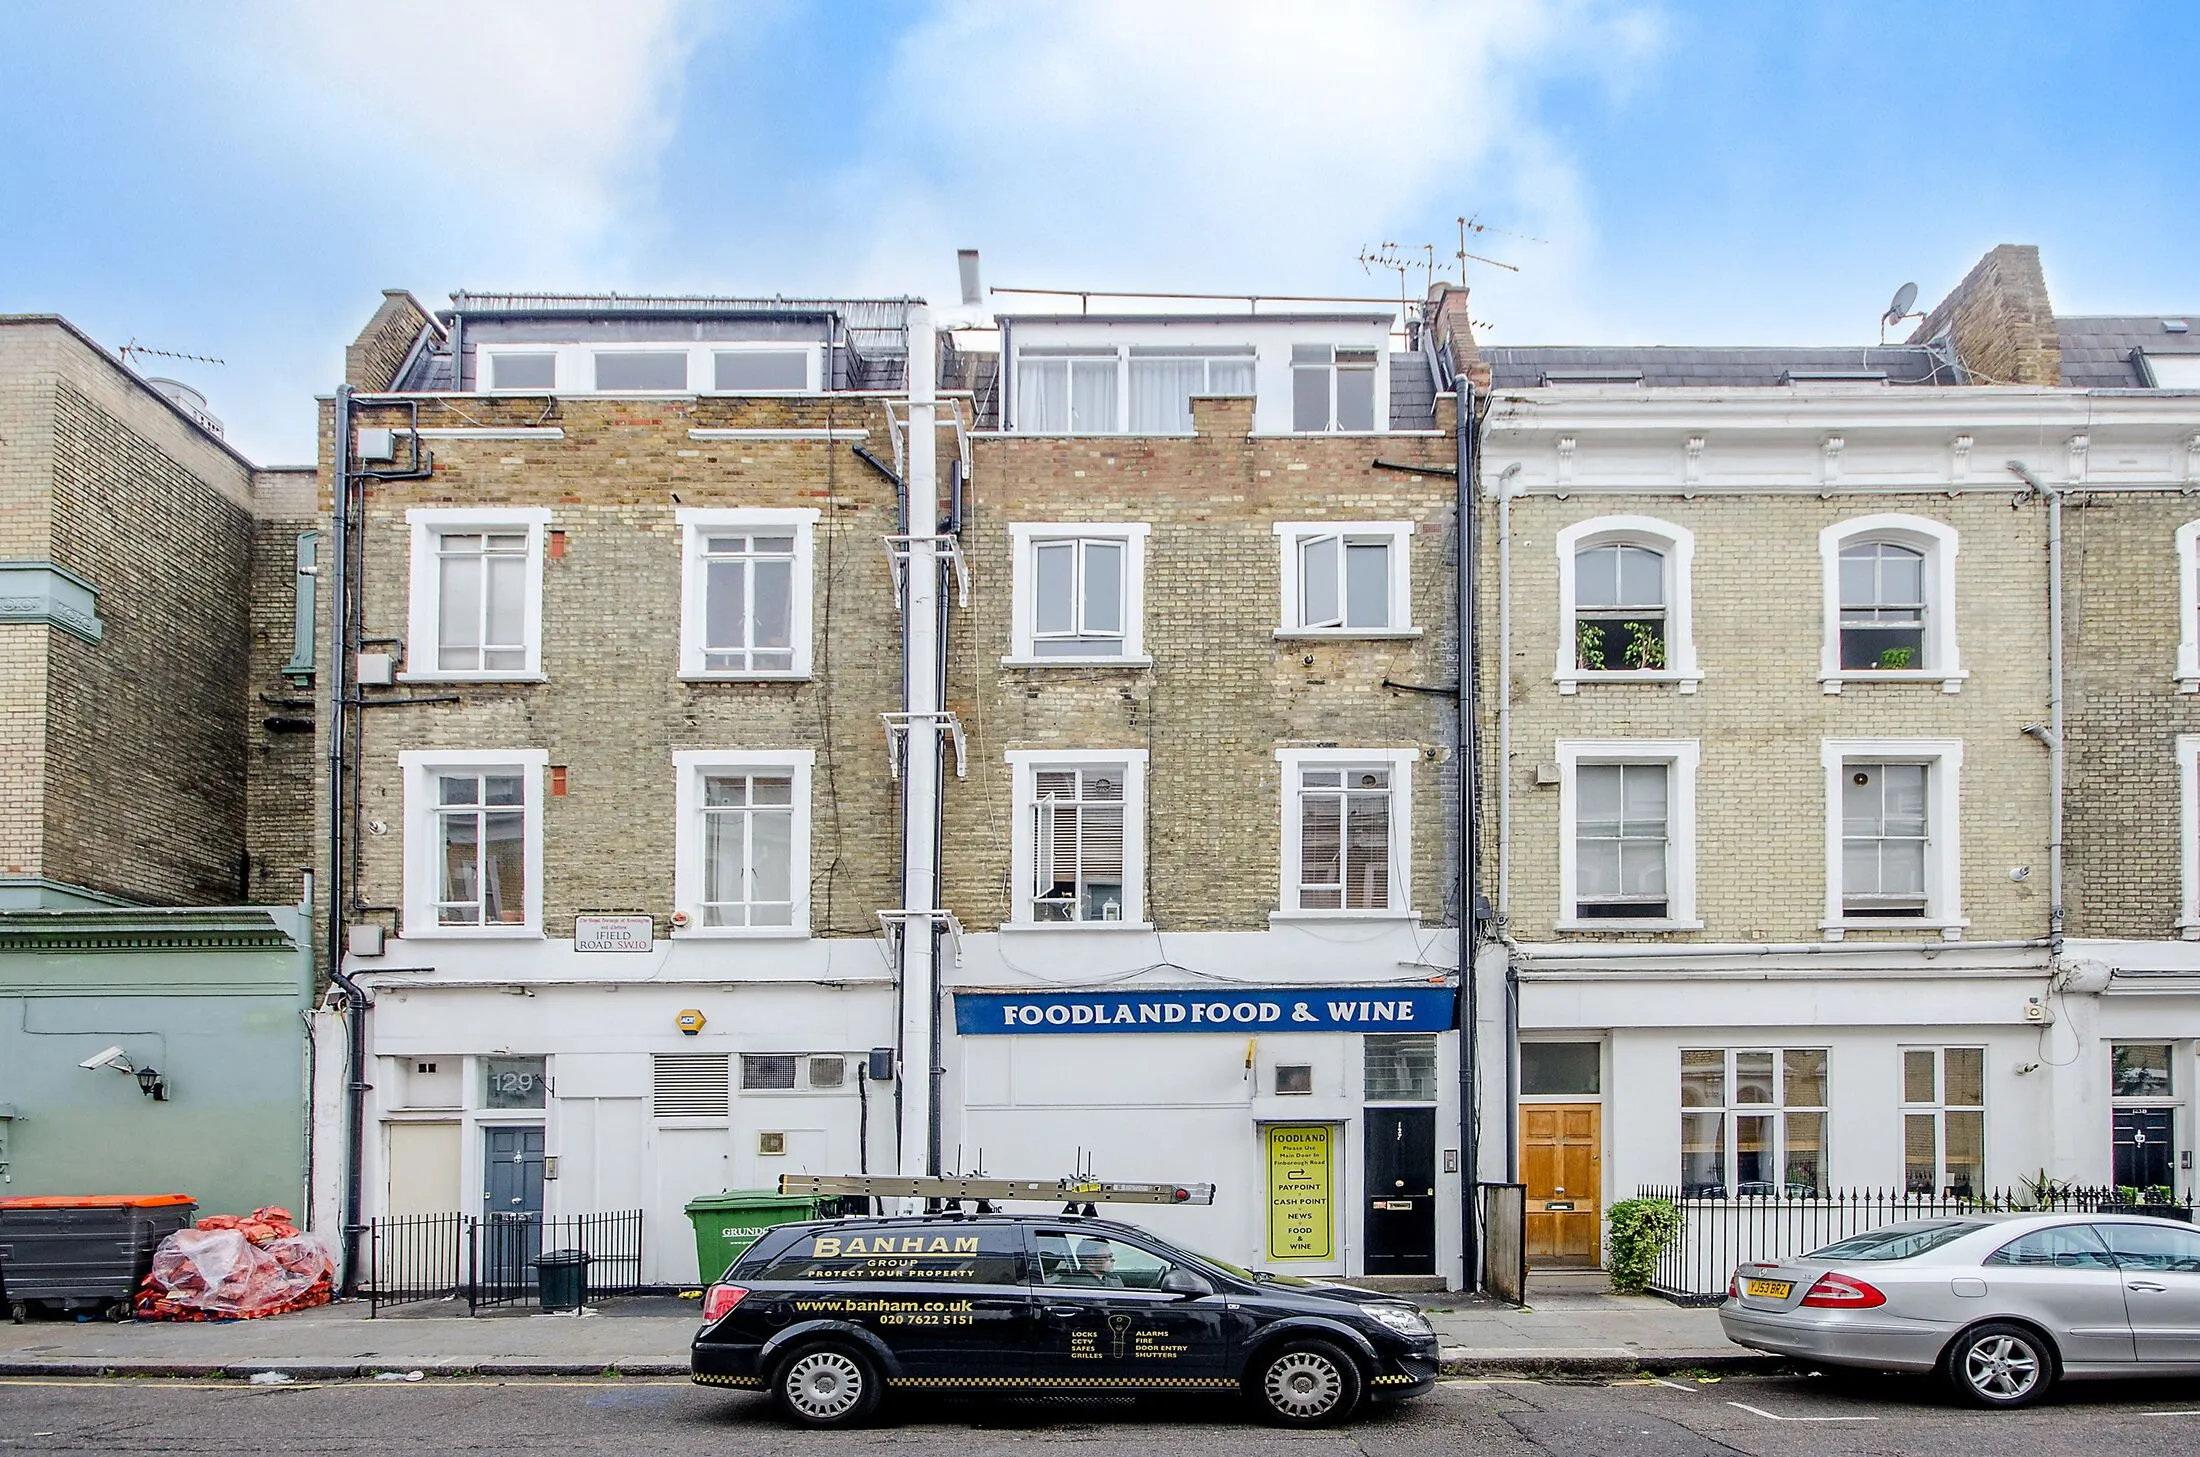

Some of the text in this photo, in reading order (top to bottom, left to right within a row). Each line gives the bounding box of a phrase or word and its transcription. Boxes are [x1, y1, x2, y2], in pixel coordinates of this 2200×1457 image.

[596, 931, 632, 940] IFIELD
[1003, 1000, 1415, 1025] FOODLAND FOOD & WINE
[492, 1073, 533, 1091] 129
[1274, 1134, 1326, 1142] FOODLAND
[813, 1237, 979, 1258] BANHAM
[867, 1259, 919, 1267] GROUP
[1750, 1281, 1787, 1295] YJ53 BRZ
[796, 1299, 973, 1312] www.banham.co.uk
[880, 1315, 973, 1325] 020 7622 5151
